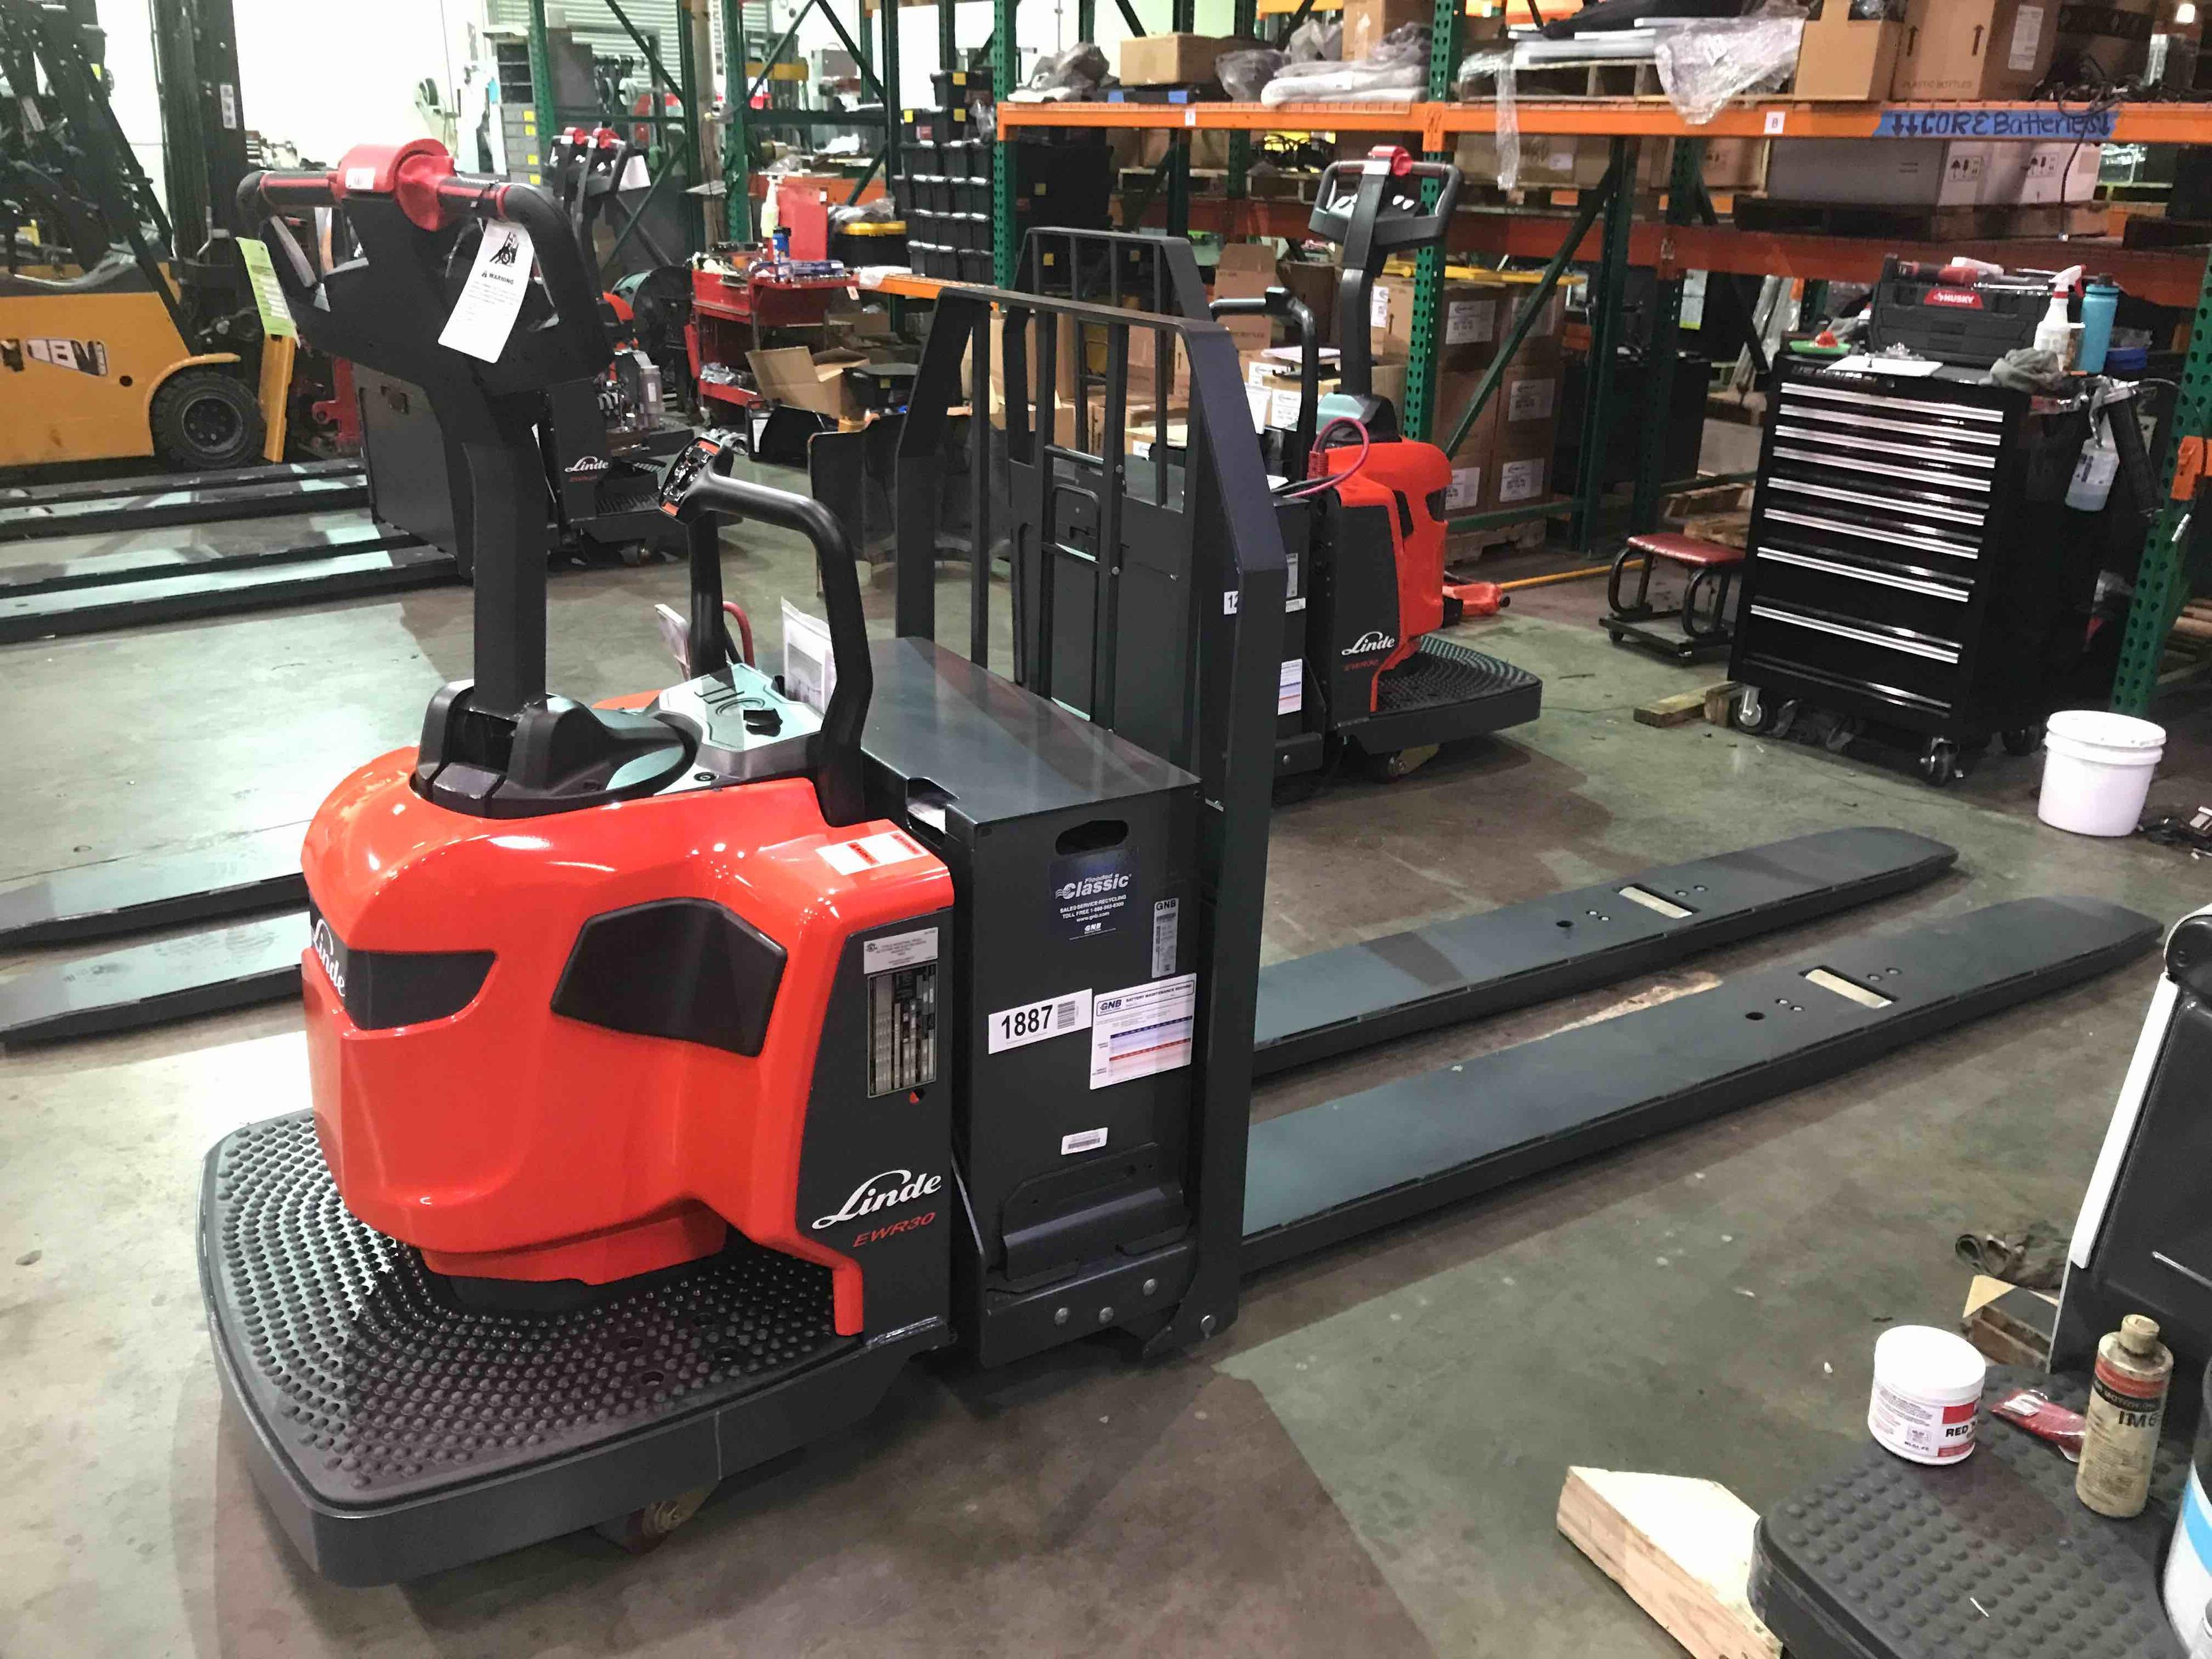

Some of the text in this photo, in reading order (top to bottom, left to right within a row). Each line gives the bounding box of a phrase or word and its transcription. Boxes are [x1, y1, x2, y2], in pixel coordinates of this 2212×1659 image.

[1921, 111, 1990, 136] CORE
[488, 272, 514, 286] WARNING
[1944, 293, 1975, 304] HUSKY
[565, 456, 609, 472] Linde
[1341, 631, 1395, 656] Linde
[1061, 873, 1130, 900] Classic
[1156, 899, 1176, 910] GNB
[1084, 922, 1102, 931] GNB
[312, 918, 346, 997] Linde
[1100, 999, 1122, 1010] GNB
[1001, 1004, 1054, 1039] 1887
[811, 1169, 942, 1230] Linde
[852, 1211, 935, 1248] EWR30
[1945, 1425, 1969, 1438] RED
